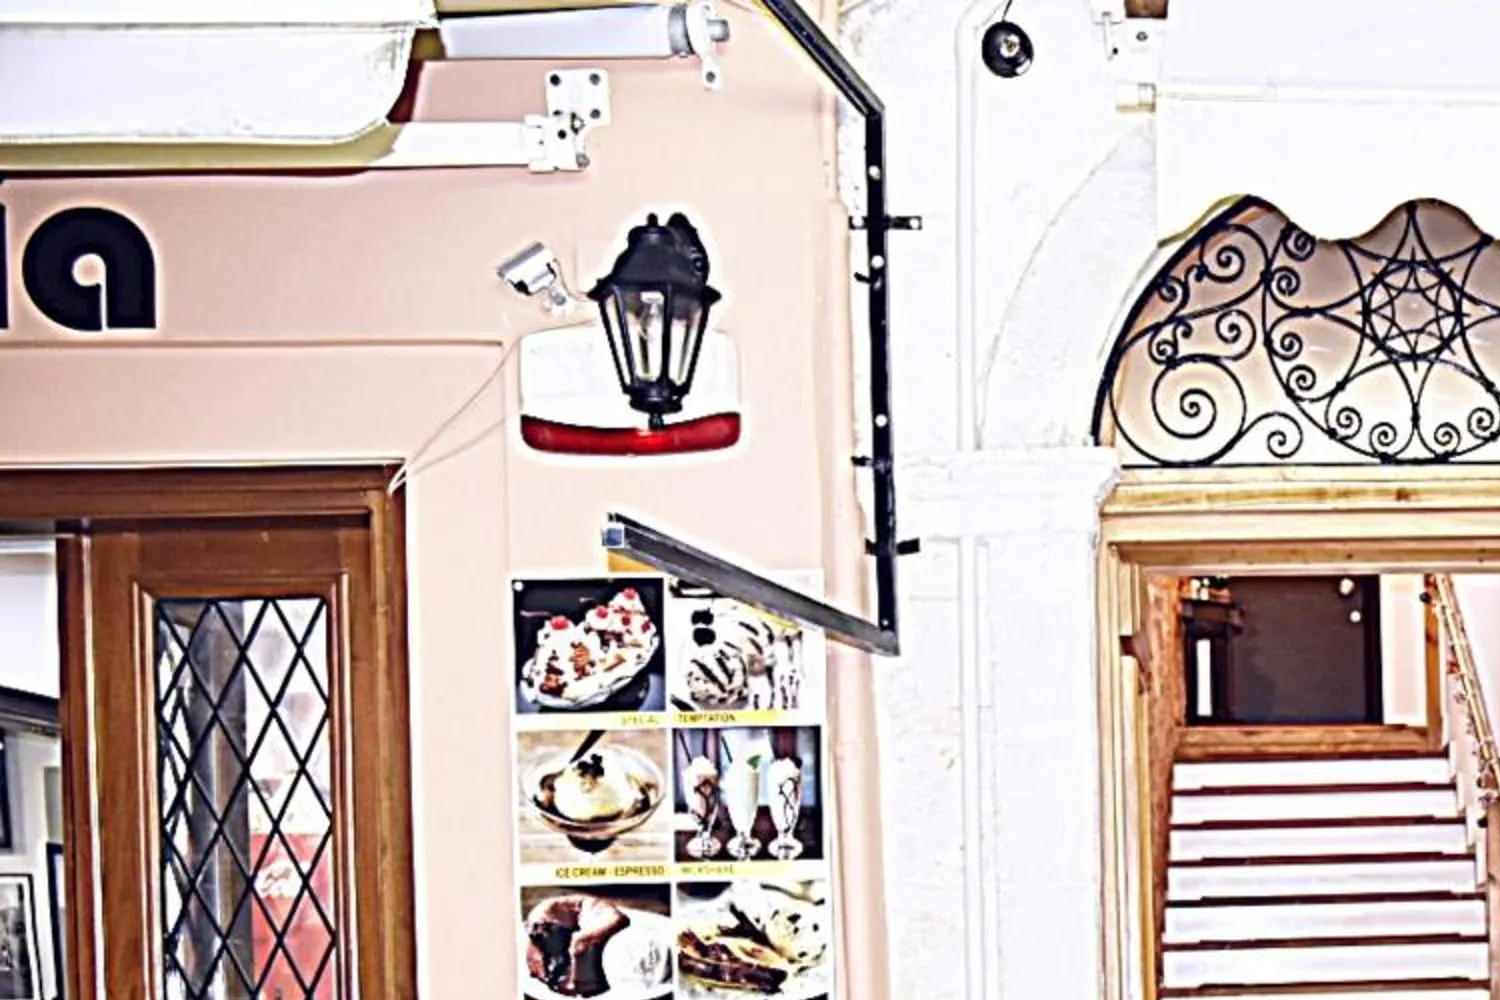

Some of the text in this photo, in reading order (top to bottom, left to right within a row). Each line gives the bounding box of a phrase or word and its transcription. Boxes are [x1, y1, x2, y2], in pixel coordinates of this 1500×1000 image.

[0, 204, 157, 332] a
[678, 713, 737, 724] TEMPTATION
[555, 867, 571, 879] ICE
[571, 867, 607, 878] CREAM
[614, 865, 666, 877] ESPRESSO
